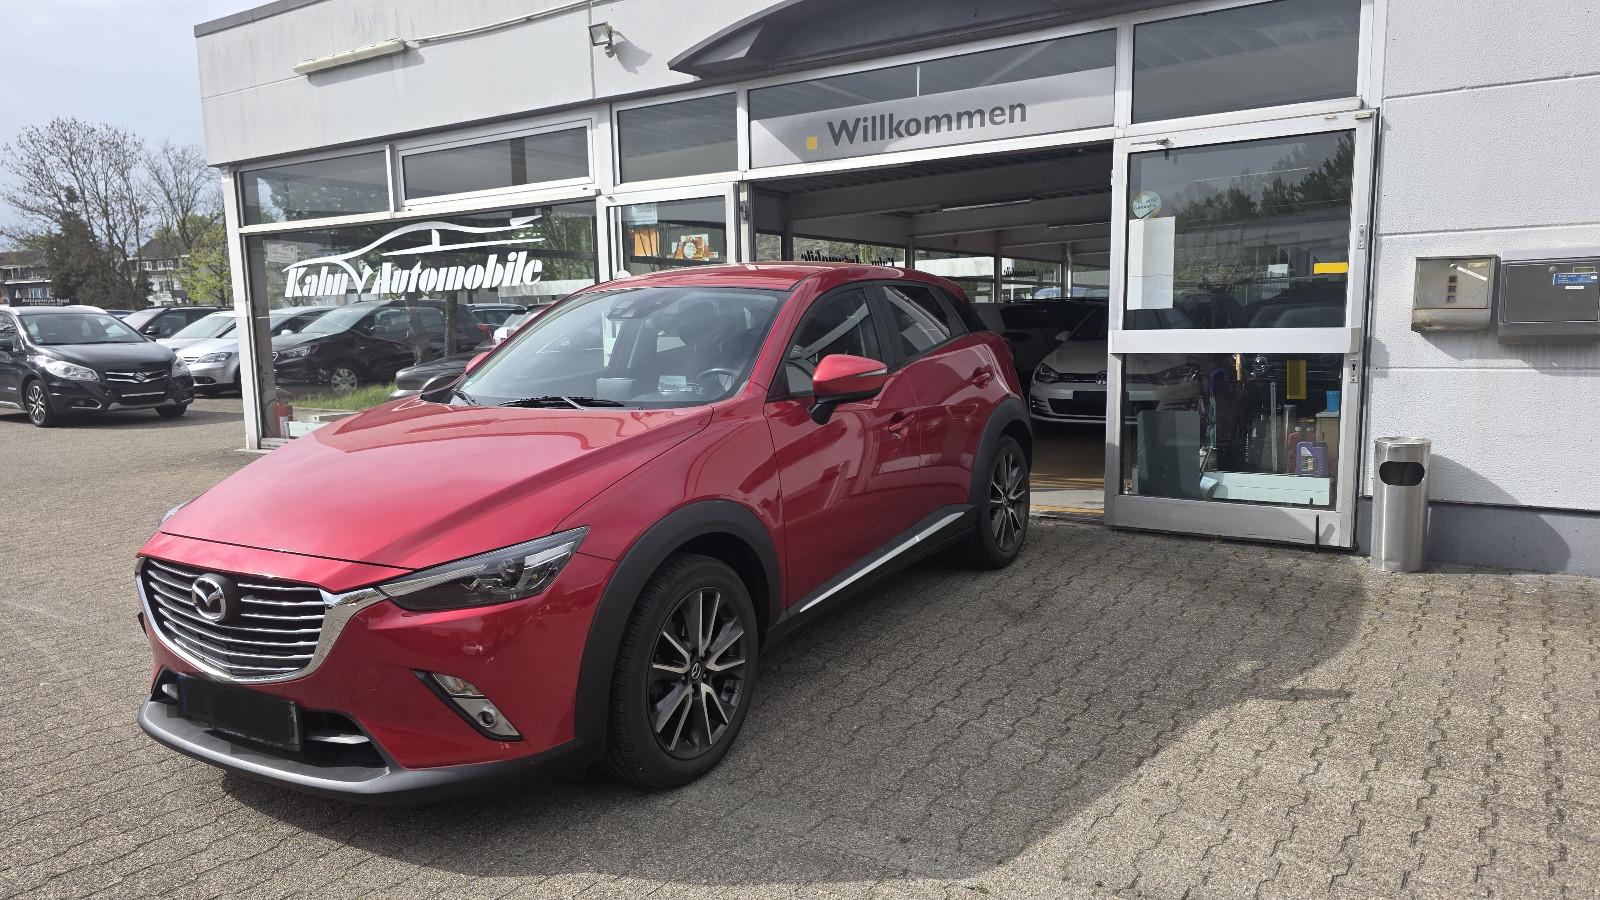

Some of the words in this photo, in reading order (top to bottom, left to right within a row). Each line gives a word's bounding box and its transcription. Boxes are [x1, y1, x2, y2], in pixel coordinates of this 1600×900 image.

[827, 102, 1027, 146] Willkommen
[285, 265, 348, 298] Kahn
[370, 251, 543, 294] Automobile
